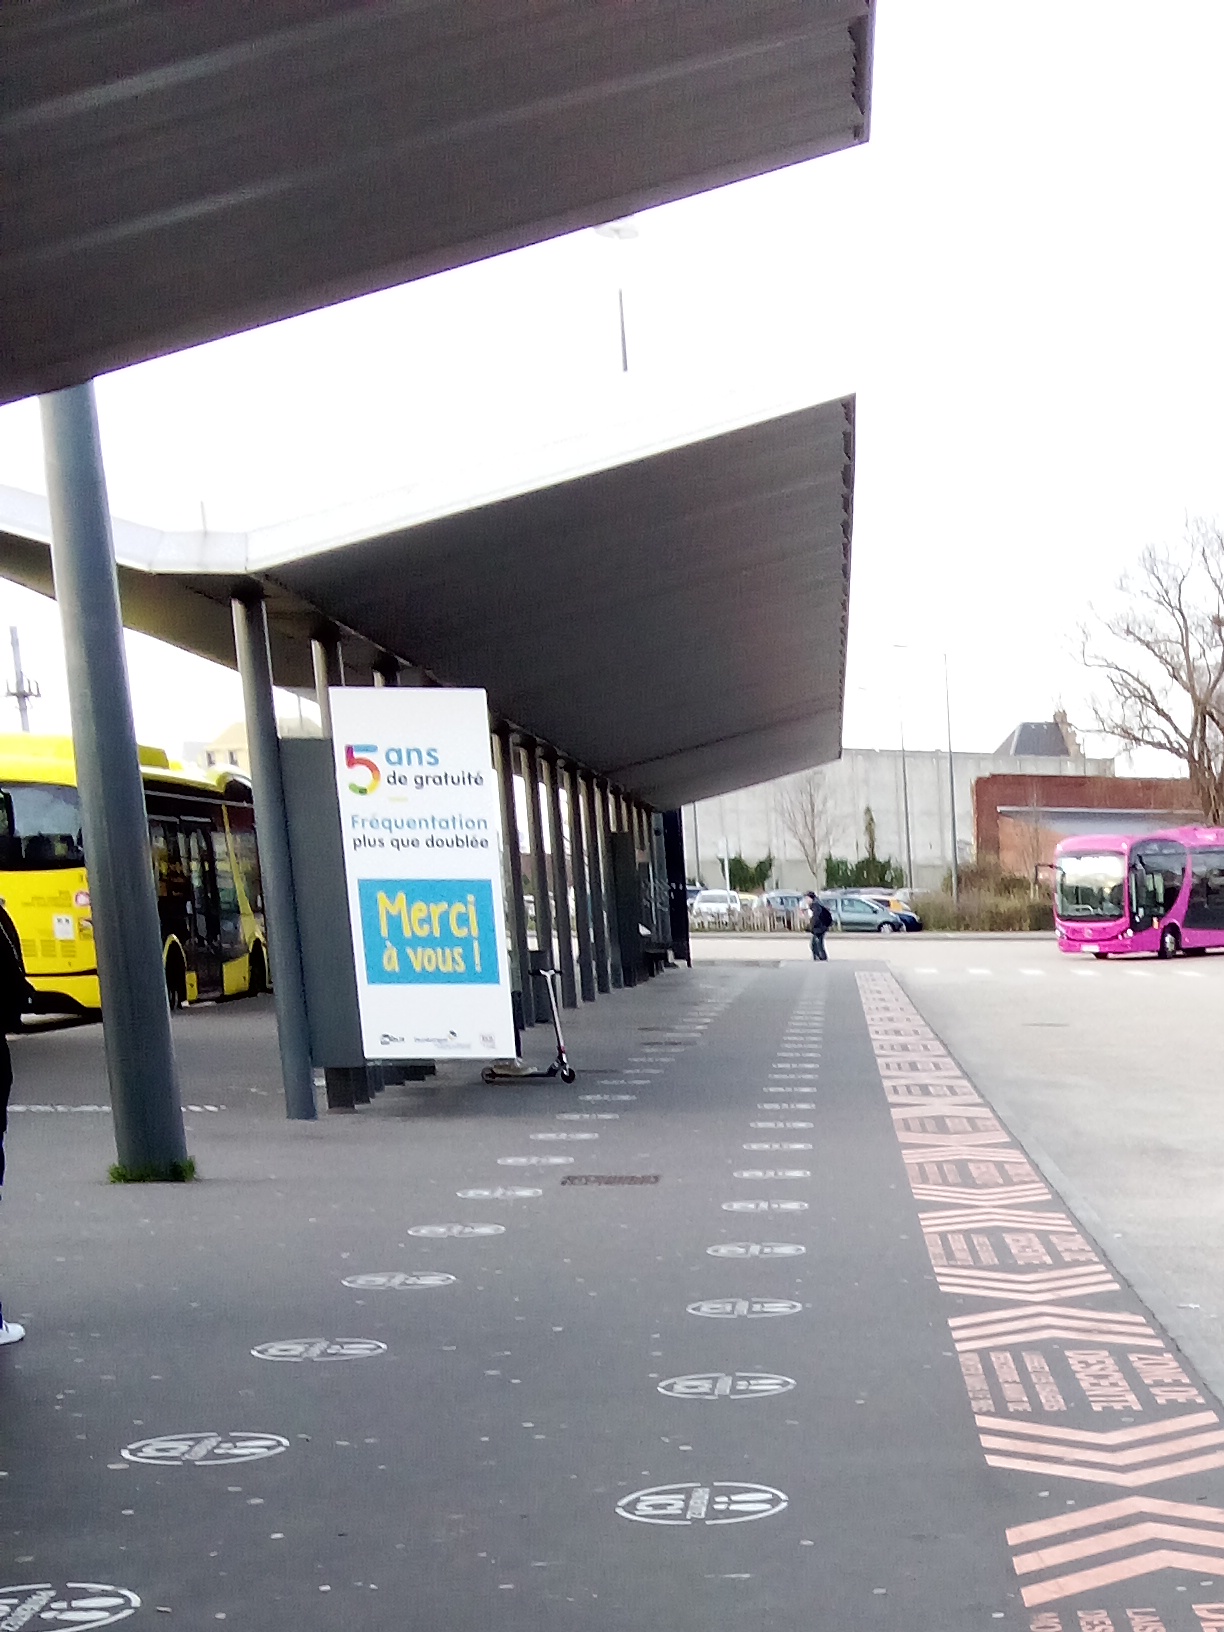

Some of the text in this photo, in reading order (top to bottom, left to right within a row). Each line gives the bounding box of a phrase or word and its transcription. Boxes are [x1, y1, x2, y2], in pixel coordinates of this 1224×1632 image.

[344, 744, 440, 796] 5 ans
[386, 768, 484, 790] de gratuité
[350, 812, 488, 833] Fréquentation
[352, 833, 489, 851] plus que doublée
[377, 890, 479, 938] Merci
[383, 937, 481, 973] à vous !
